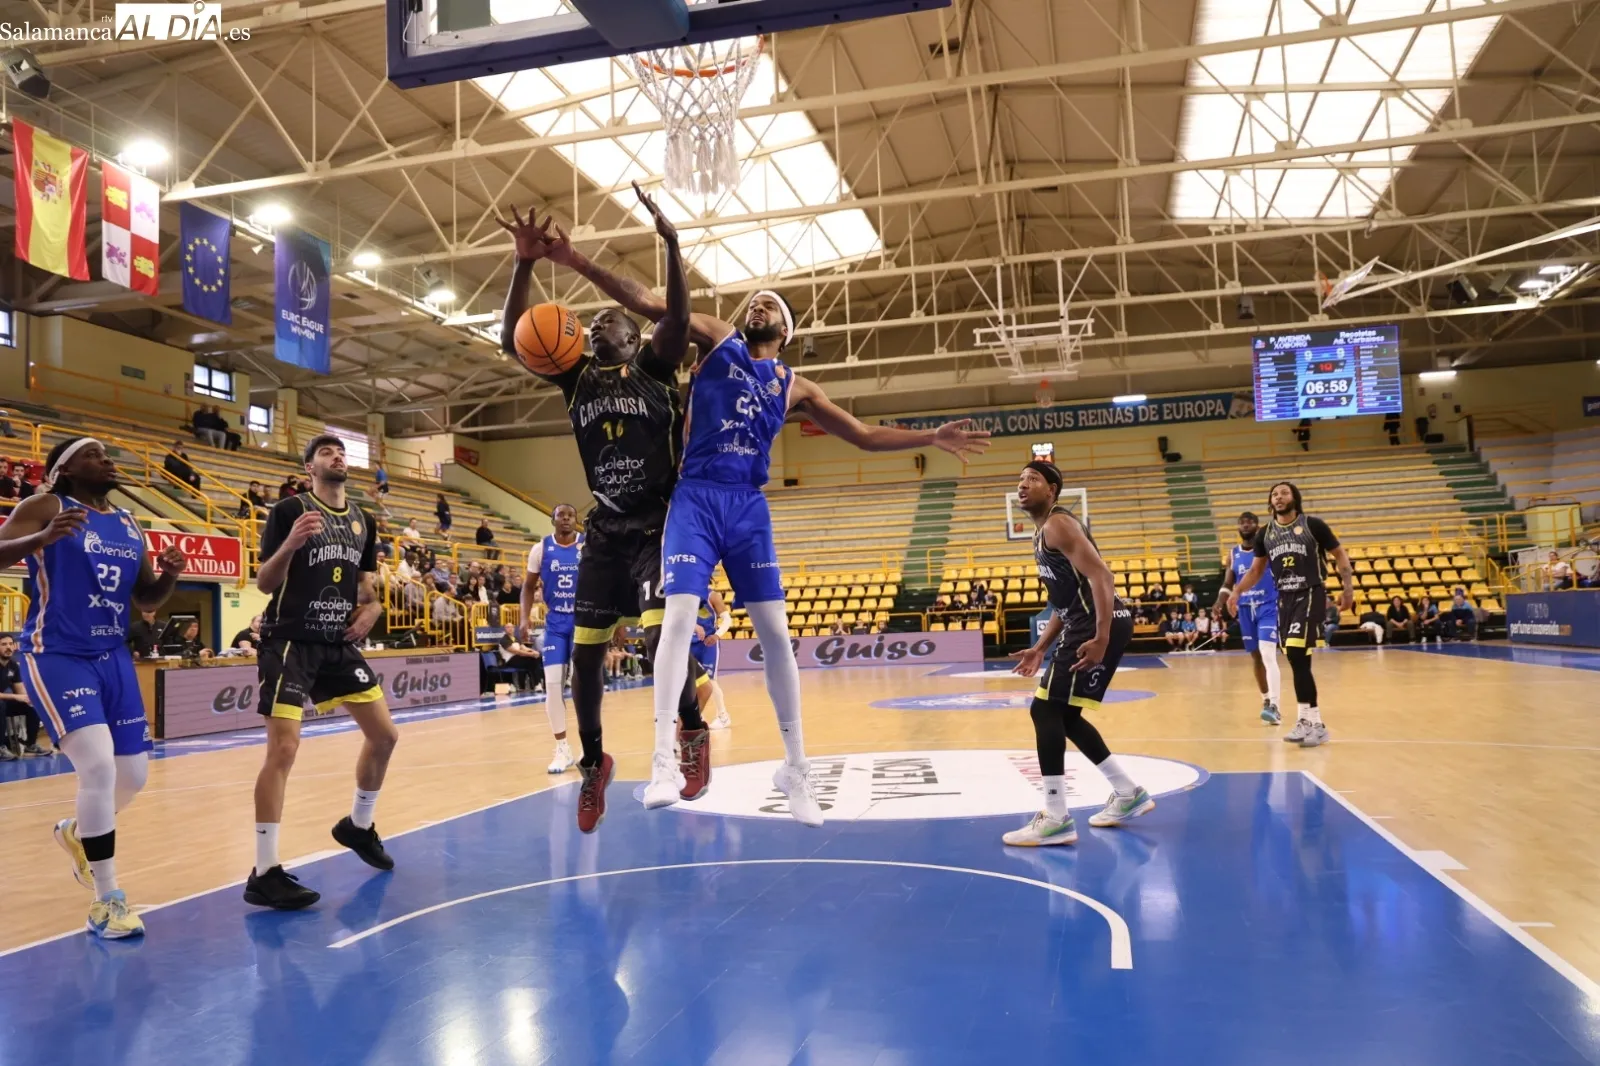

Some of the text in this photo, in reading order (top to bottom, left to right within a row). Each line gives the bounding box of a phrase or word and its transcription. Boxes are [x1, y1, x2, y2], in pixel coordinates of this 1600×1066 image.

[1306, 379, 1348, 394] 06:58
[1309, 398, 1316, 408] 0
[1340, 396, 1348, 405] 3
[1007, 413, 1040, 433] CON
[1044, 410, 1074, 429] SUS
[1078, 406, 1134, 427] REINAS
[1138, 405, 1159, 422] DE
[1163, 399, 1227, 420] EUROPA
[602, 419, 624, 440] 16
[594, 455, 645, 476] reoletas
[600, 470, 633, 485] salud
[96, 563, 121, 592] 23
[332, 566, 342, 583] 8
[557, 574, 573, 589] 25
[308, 599, 353, 611] recoleta
[319, 610, 347, 622] salud
[815, 635, 937, 665] Guiso
[355, 668, 369, 683] 8
[391, 669, 452, 699] Guiso
